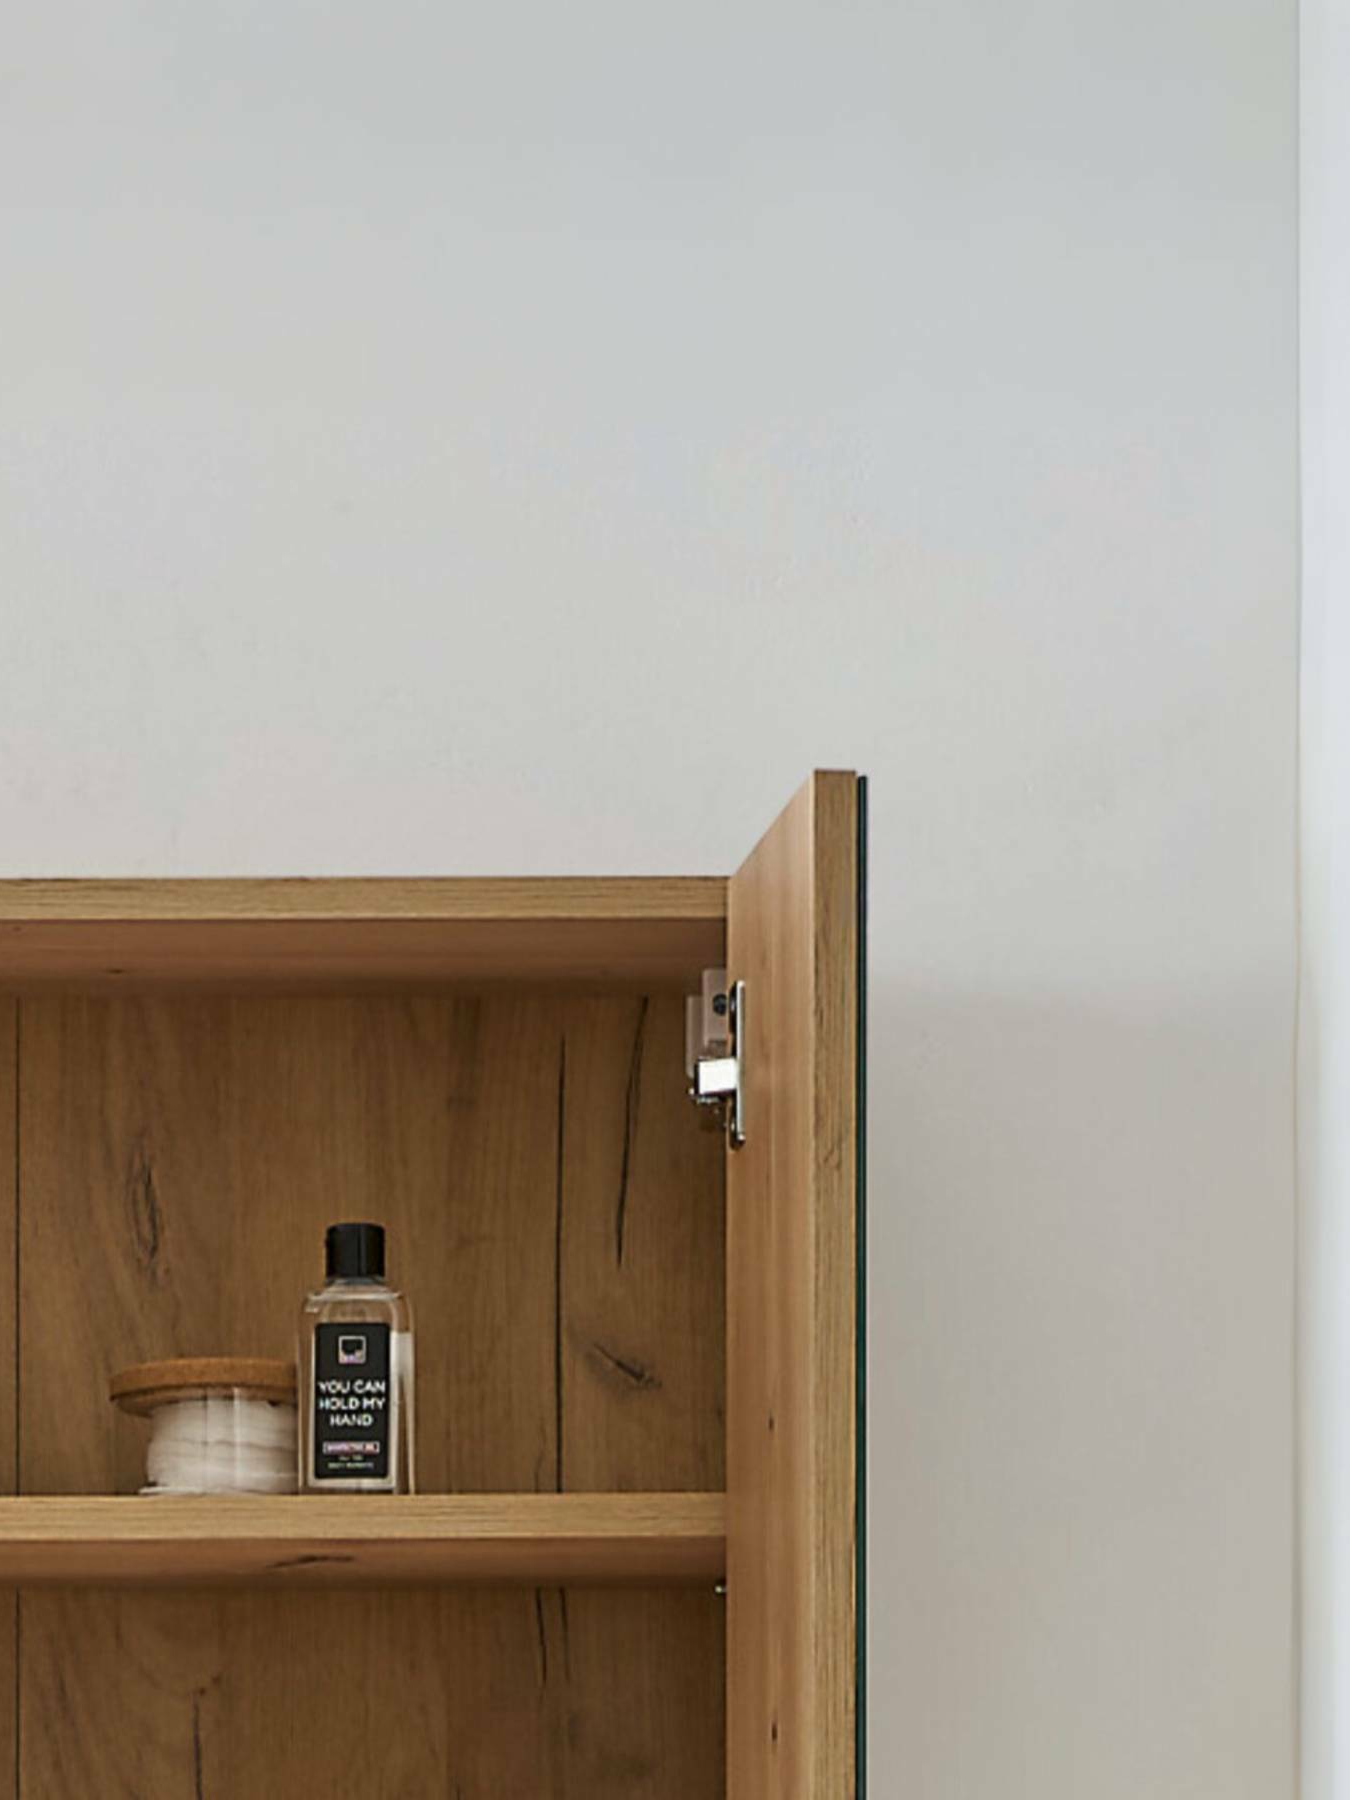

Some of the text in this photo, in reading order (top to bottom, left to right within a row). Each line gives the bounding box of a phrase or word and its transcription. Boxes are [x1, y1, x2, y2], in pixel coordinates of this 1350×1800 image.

[318, 1380, 386, 1394] YOU CAN
[319, 1397, 386, 1411] HOLD MY
[330, 1413, 373, 1427] HAND
